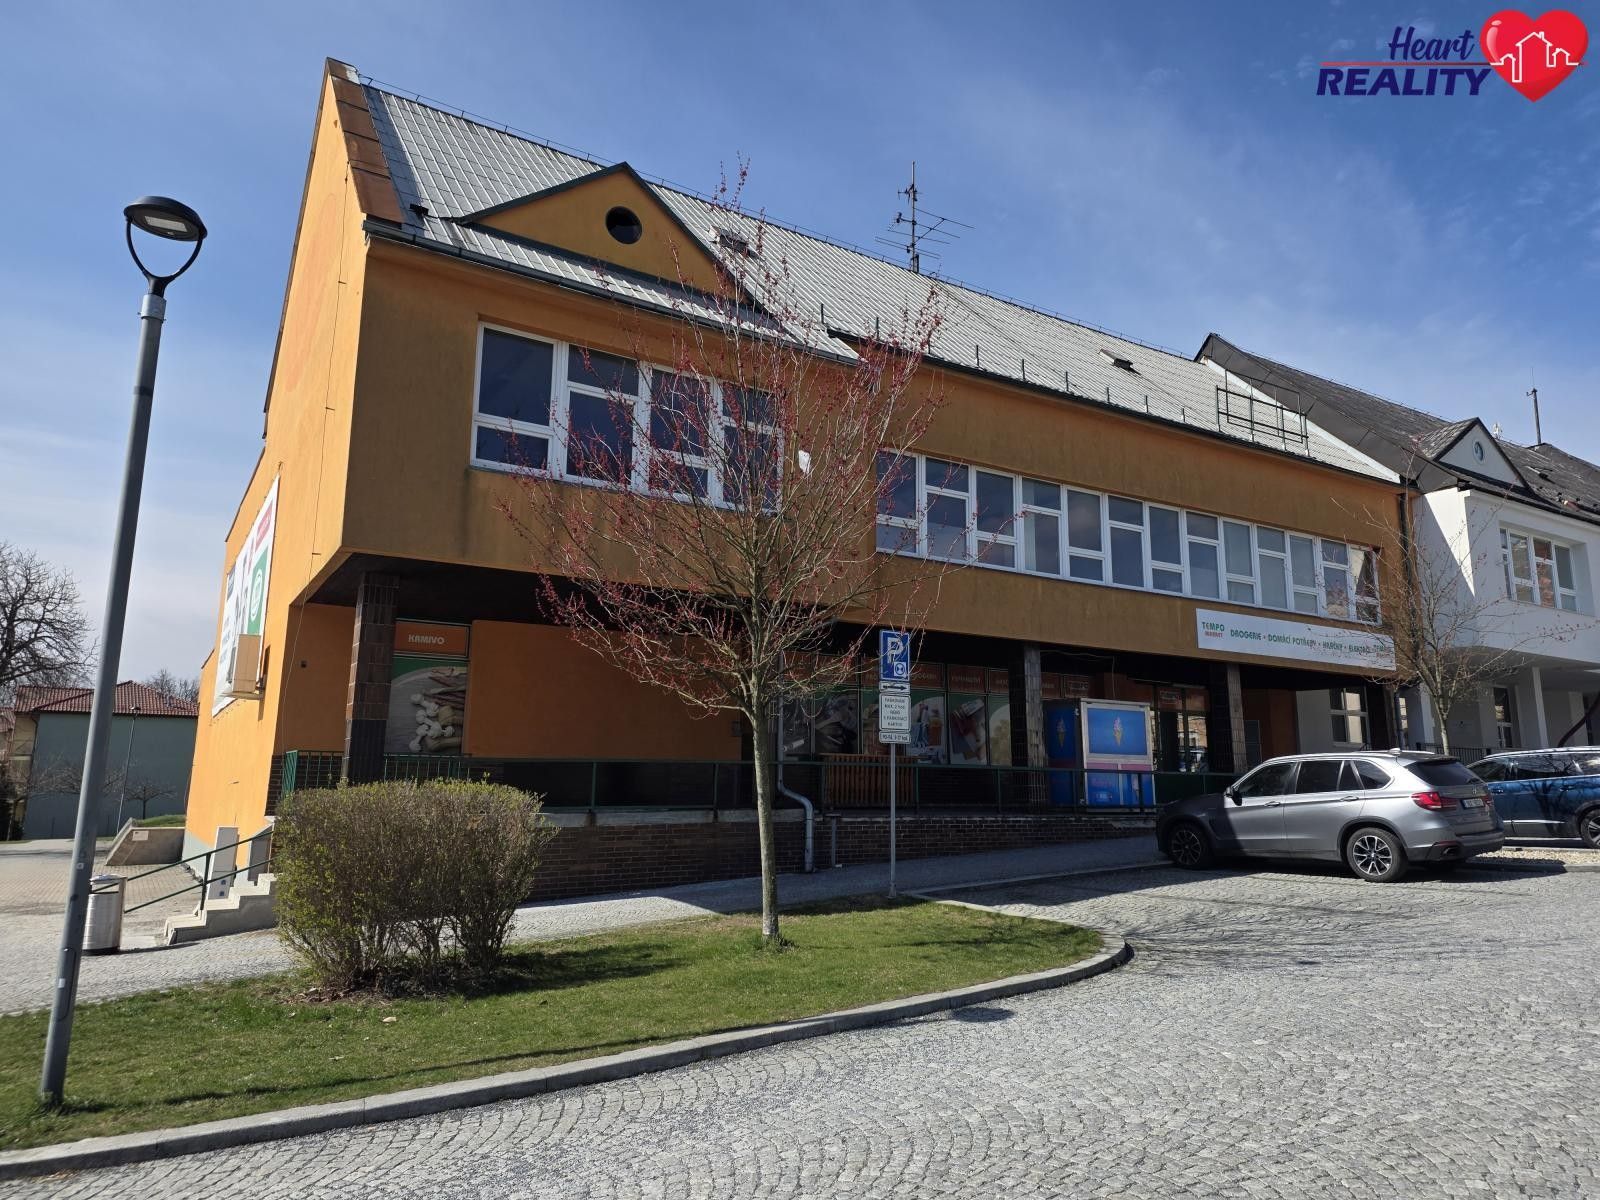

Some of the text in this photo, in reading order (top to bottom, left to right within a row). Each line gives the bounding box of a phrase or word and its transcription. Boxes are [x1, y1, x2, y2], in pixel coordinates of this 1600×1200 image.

[1202, 621, 1225, 632] TEMPO
[1230, 629, 1262, 641] DROGERIE
[887, 636, 904, 664] P
